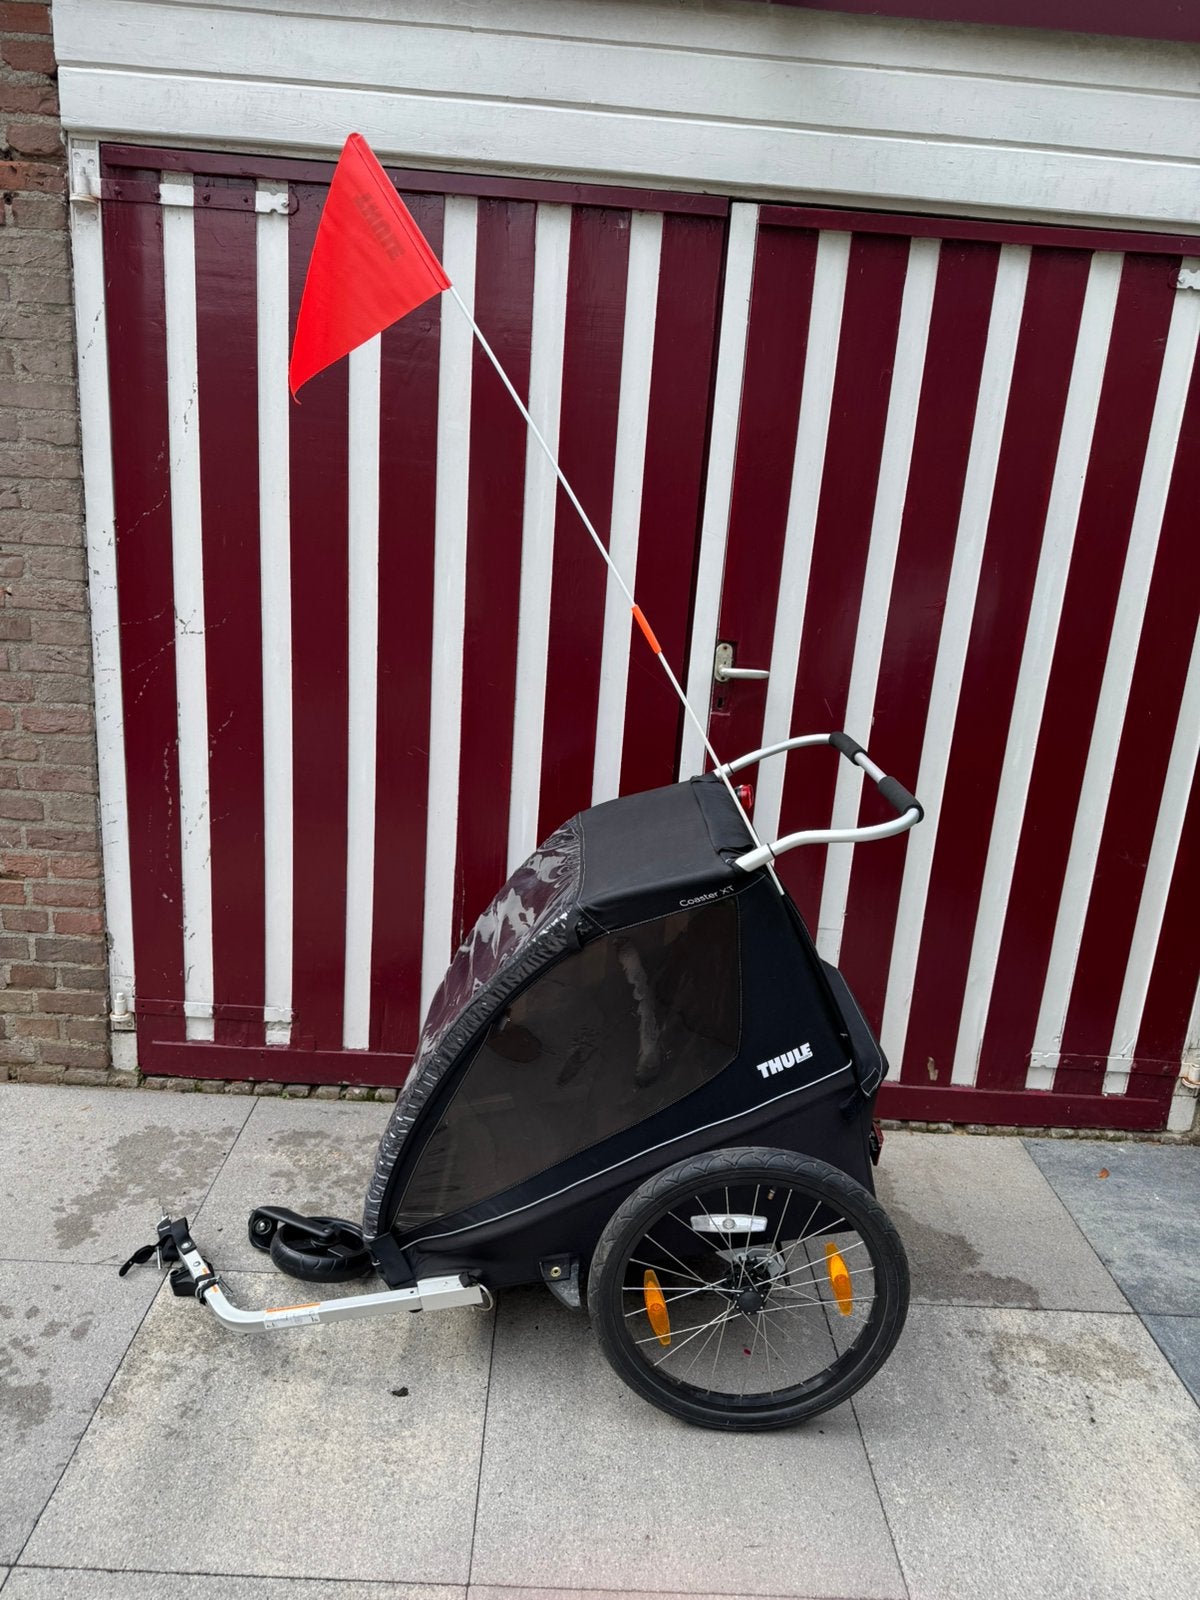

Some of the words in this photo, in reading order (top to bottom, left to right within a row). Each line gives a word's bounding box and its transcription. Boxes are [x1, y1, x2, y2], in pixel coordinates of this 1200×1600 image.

[679, 892, 718, 907] Coaster
[719, 885, 734, 895] XT
[756, 1042, 813, 1079] THULE
